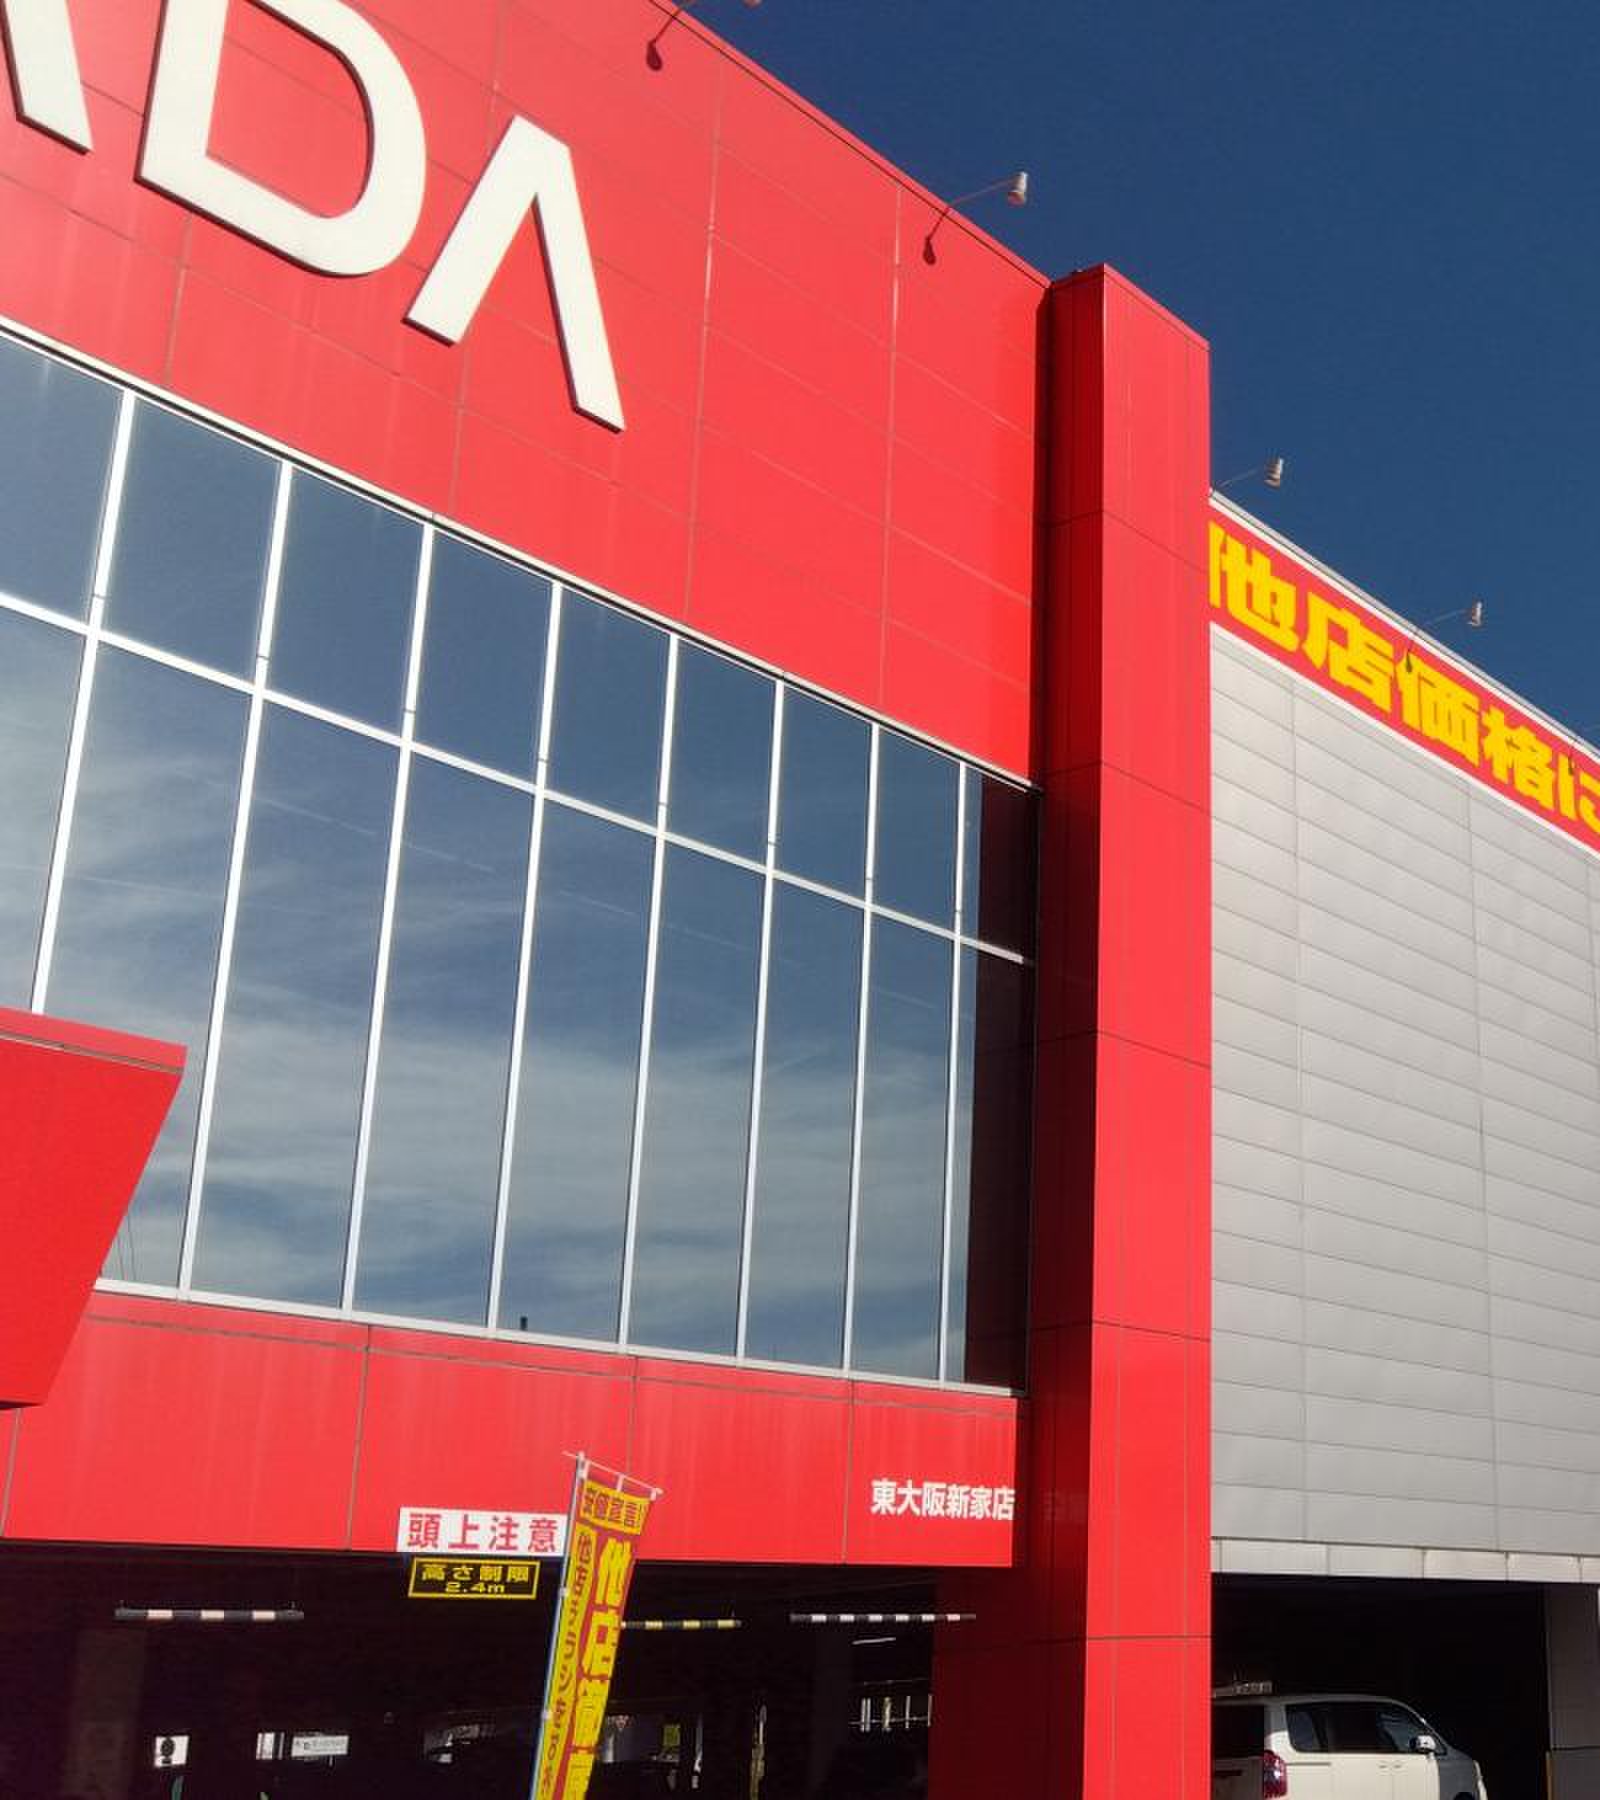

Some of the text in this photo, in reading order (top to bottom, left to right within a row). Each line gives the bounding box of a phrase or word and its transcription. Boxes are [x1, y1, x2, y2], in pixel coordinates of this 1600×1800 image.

[0, 0, 626, 432] DA
[870, 1477, 1016, 1521] 東大阪新家店
[407, 1512, 559, 1553] 頭上注意
[421, 1564, 529, 1583] 高さ制限
[445, 1581, 505, 1594] 2.4m
